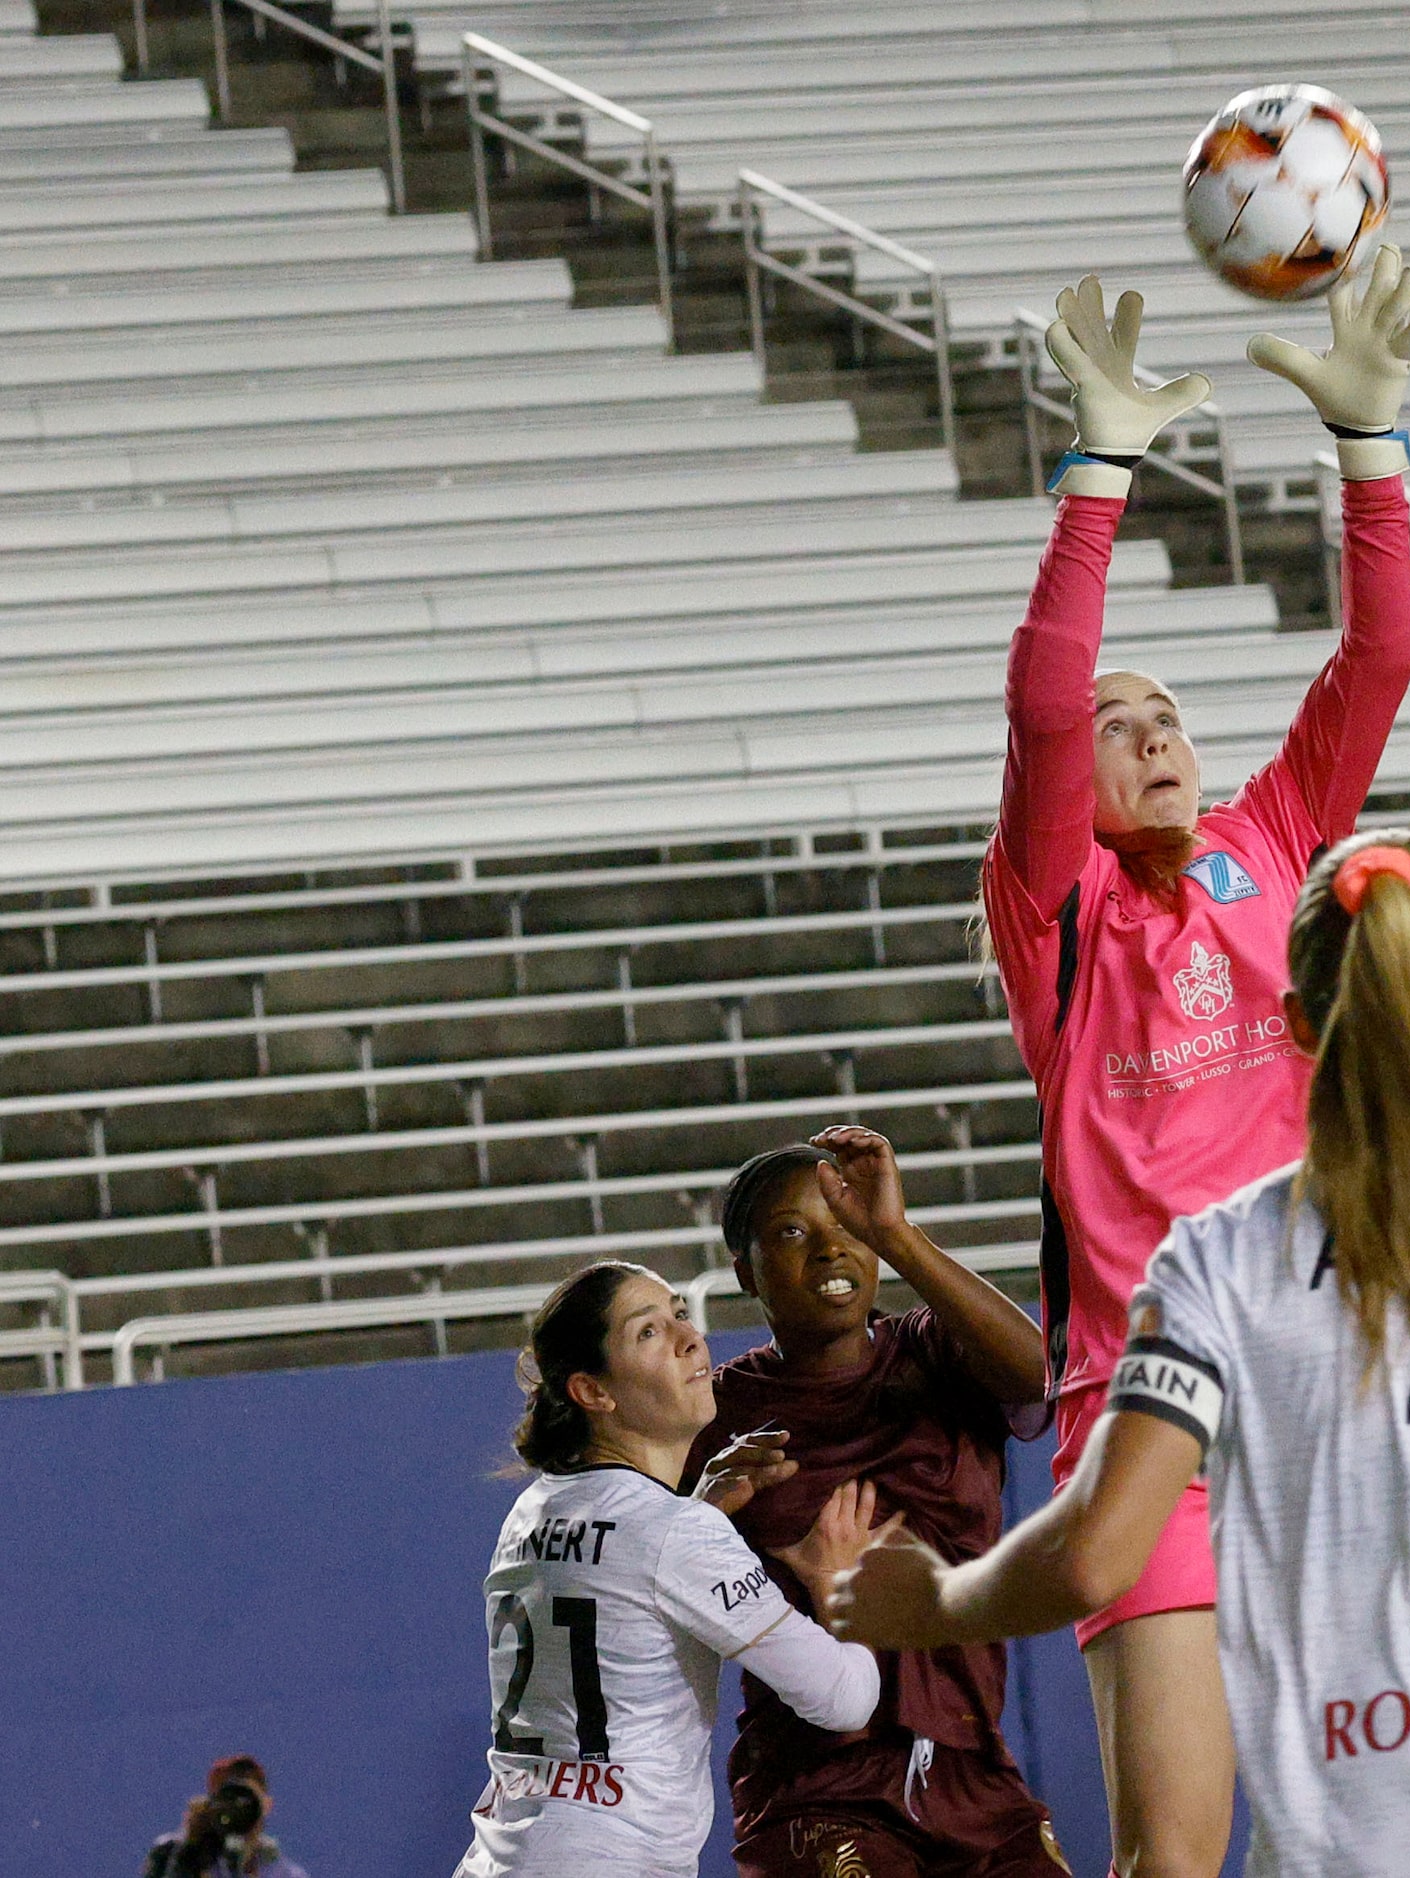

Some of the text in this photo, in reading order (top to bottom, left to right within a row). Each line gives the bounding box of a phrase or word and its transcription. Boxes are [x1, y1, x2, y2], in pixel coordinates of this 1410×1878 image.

[1106, 1015, 1287, 1076] DAVENPORT HO
[1107, 1086, 1153, 1099] HISTORIC
[1162, 1076, 1196, 1092] TOWER
[1200, 1063, 1231, 1081] LUSSO
[1238, 1052, 1276, 1070] GRAND
[490, 1594, 610, 1764] 21
